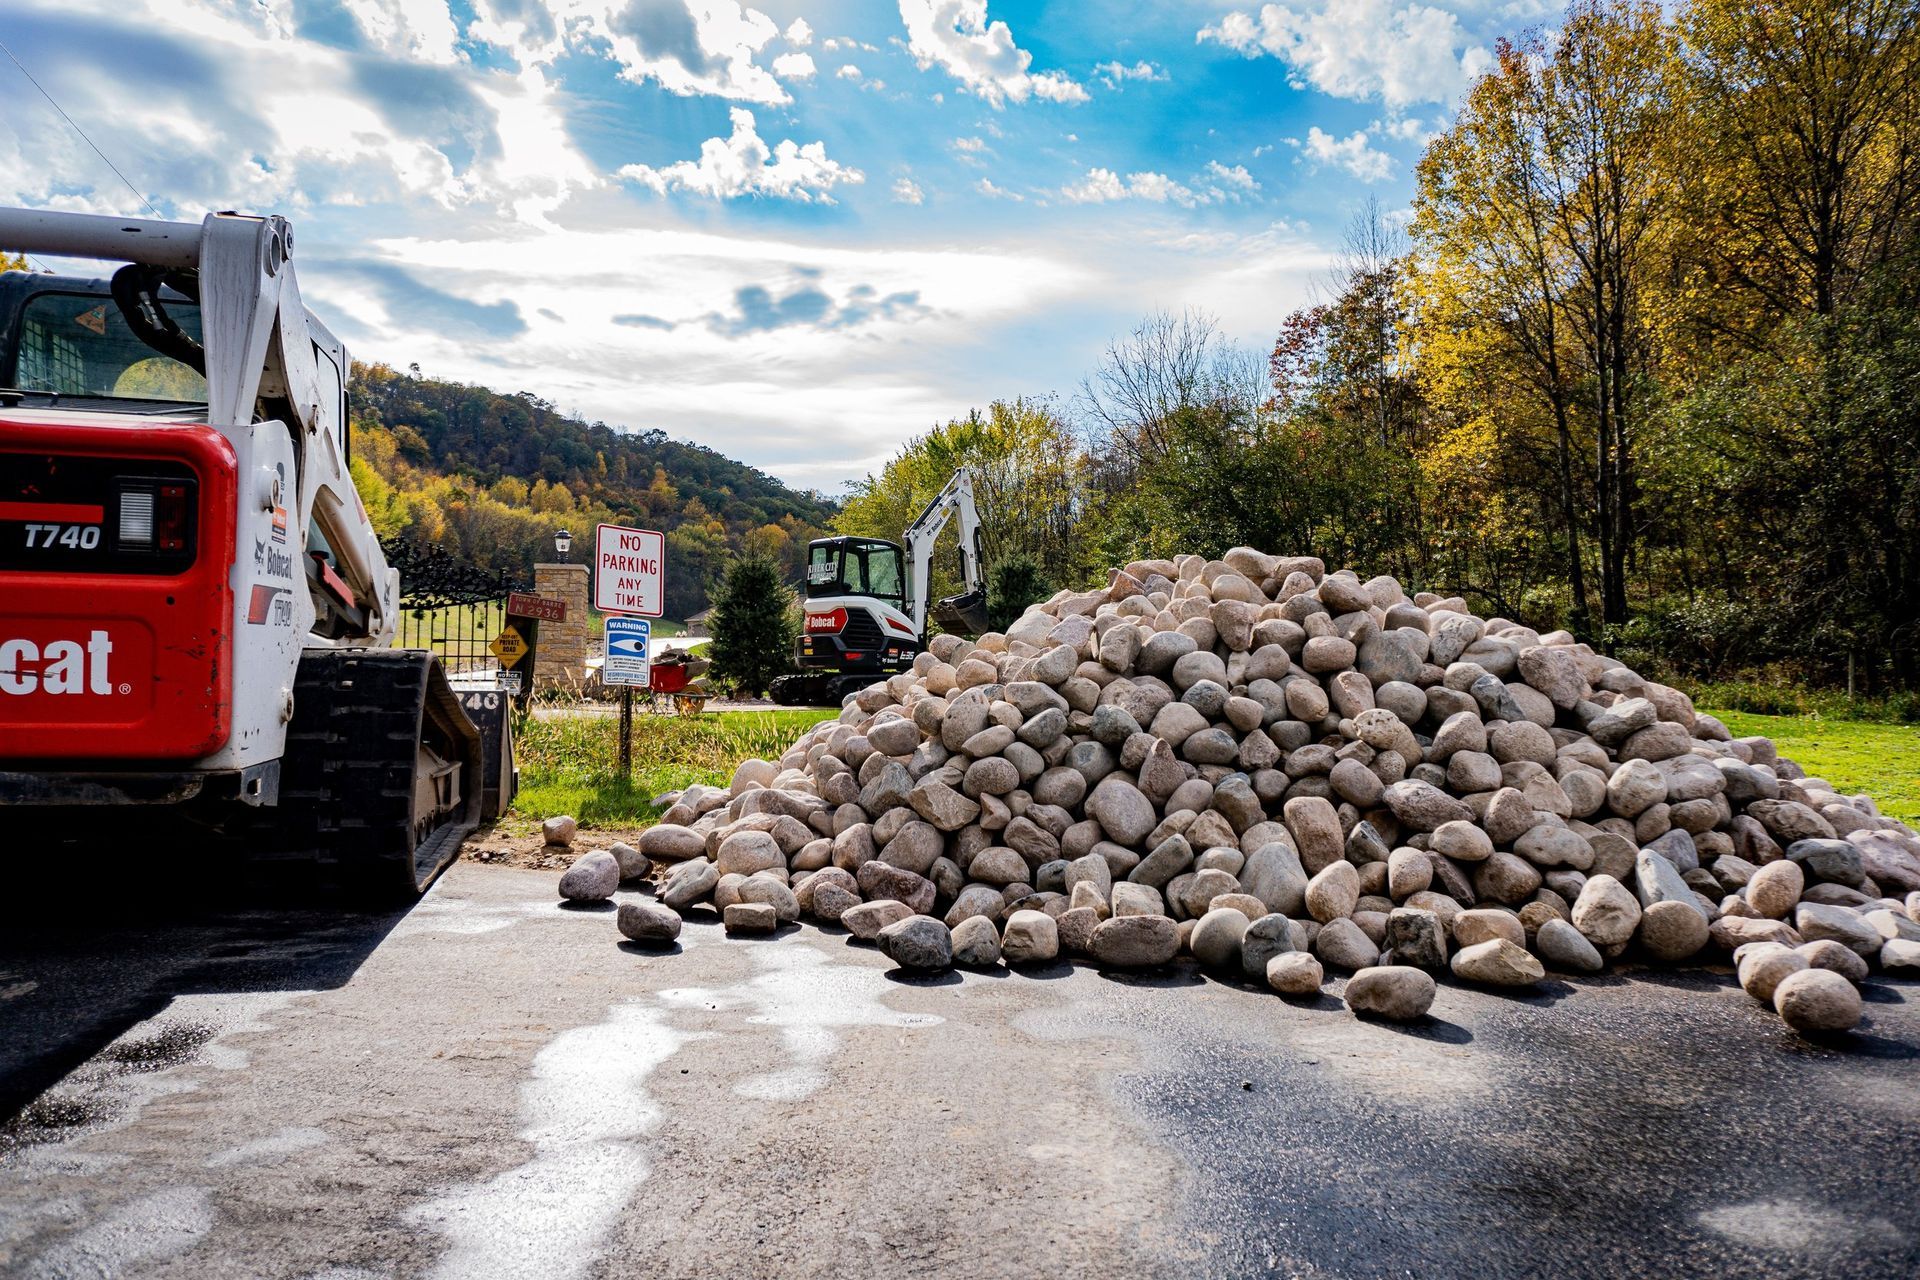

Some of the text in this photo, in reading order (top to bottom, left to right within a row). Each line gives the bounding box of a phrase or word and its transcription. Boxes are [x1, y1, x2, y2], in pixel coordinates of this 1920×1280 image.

[24, 524, 101, 550] T740
[620, 534, 641, 551] NO
[267, 546, 293, 580] Bobcat
[603, 553, 657, 575] PARKING
[617, 577, 642, 591] ANY
[615, 592, 644, 608] TIME
[274, 599, 292, 627] T740
[527, 605, 559, 619] 2936
[609, 621, 647, 632] WARNING
[810, 616, 836, 628] Bobcat
[499, 639, 520, 647] PRIVATE
